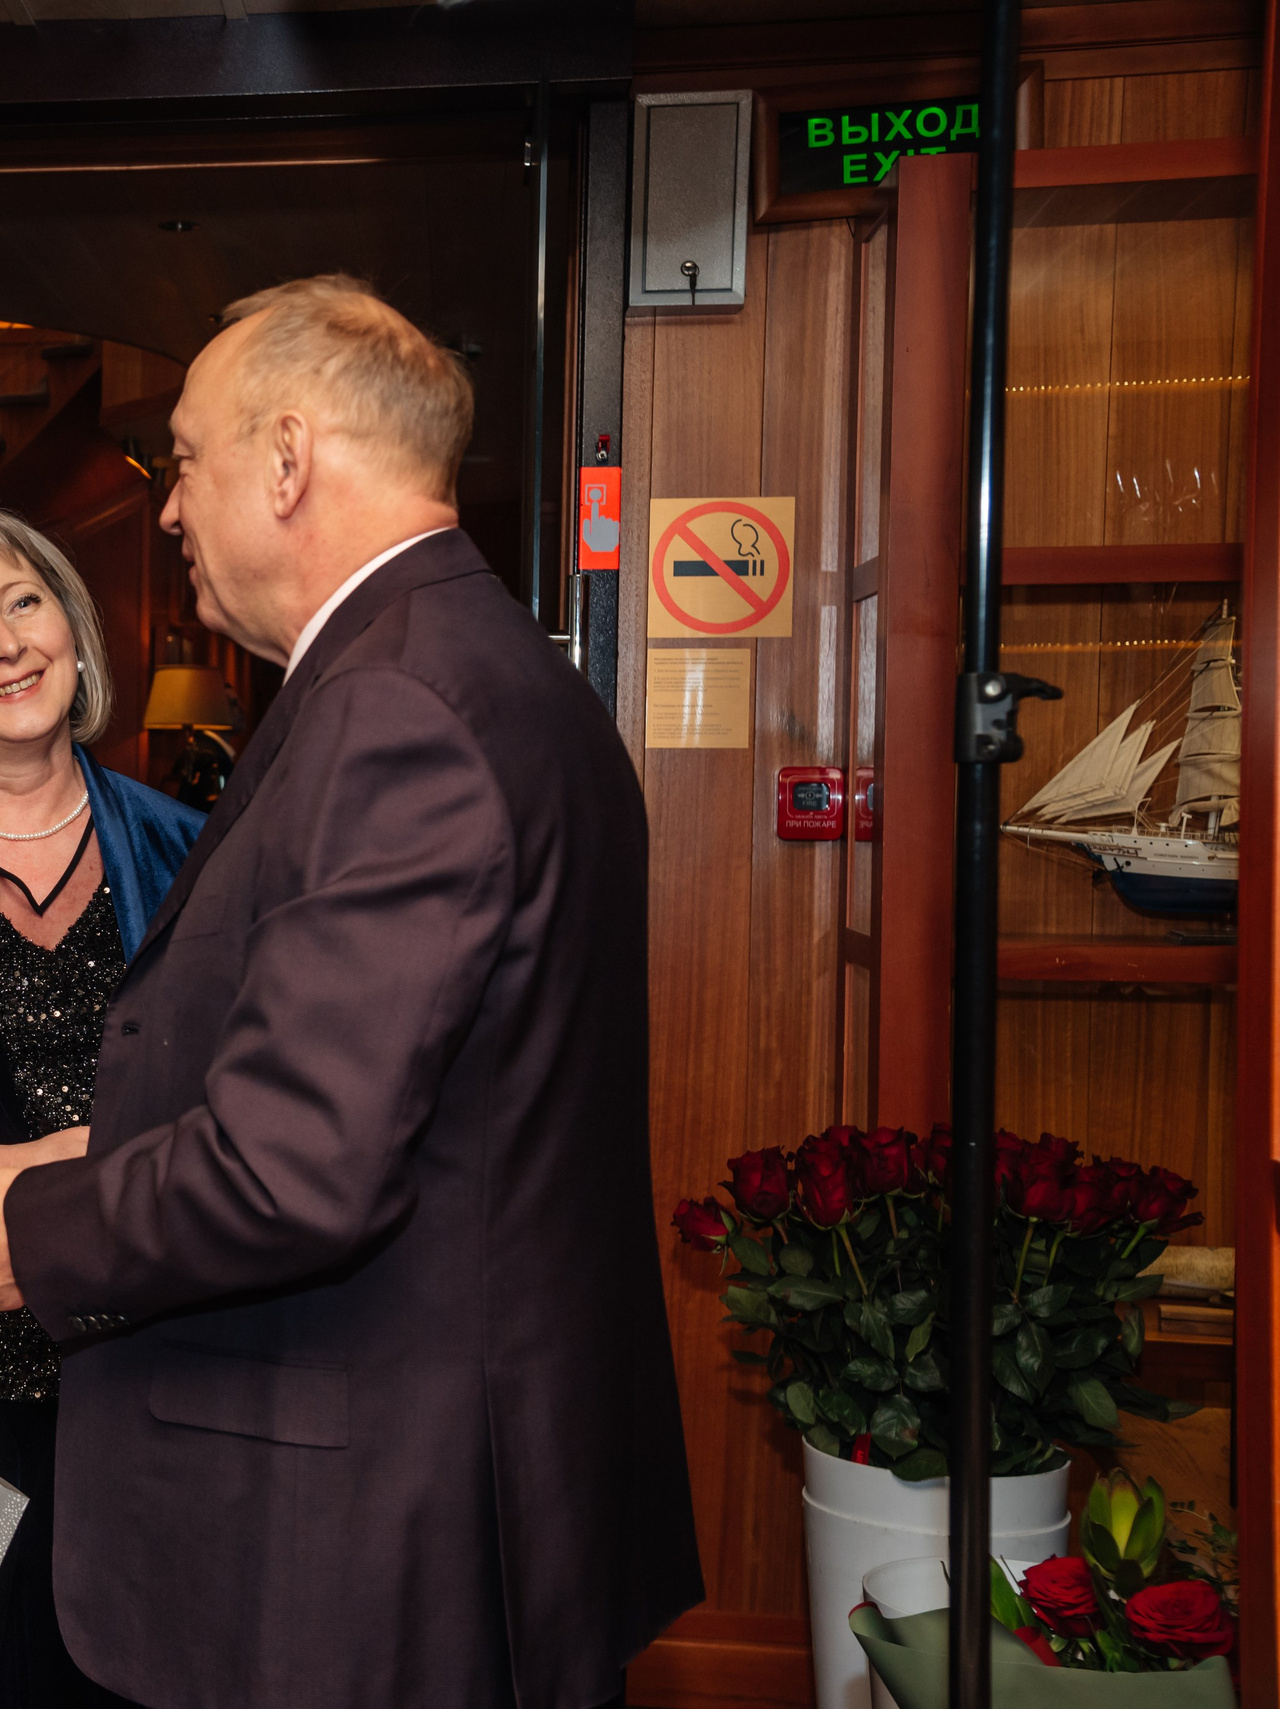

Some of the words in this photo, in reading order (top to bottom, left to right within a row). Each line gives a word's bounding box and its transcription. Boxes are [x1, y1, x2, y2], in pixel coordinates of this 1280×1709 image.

[807, 103, 980, 148] ВЫХОД
[843, 146, 947, 184] EX
[785, 820, 802, 828] ПРИ
[803, 820, 837, 829] ПОЖАРЕ
